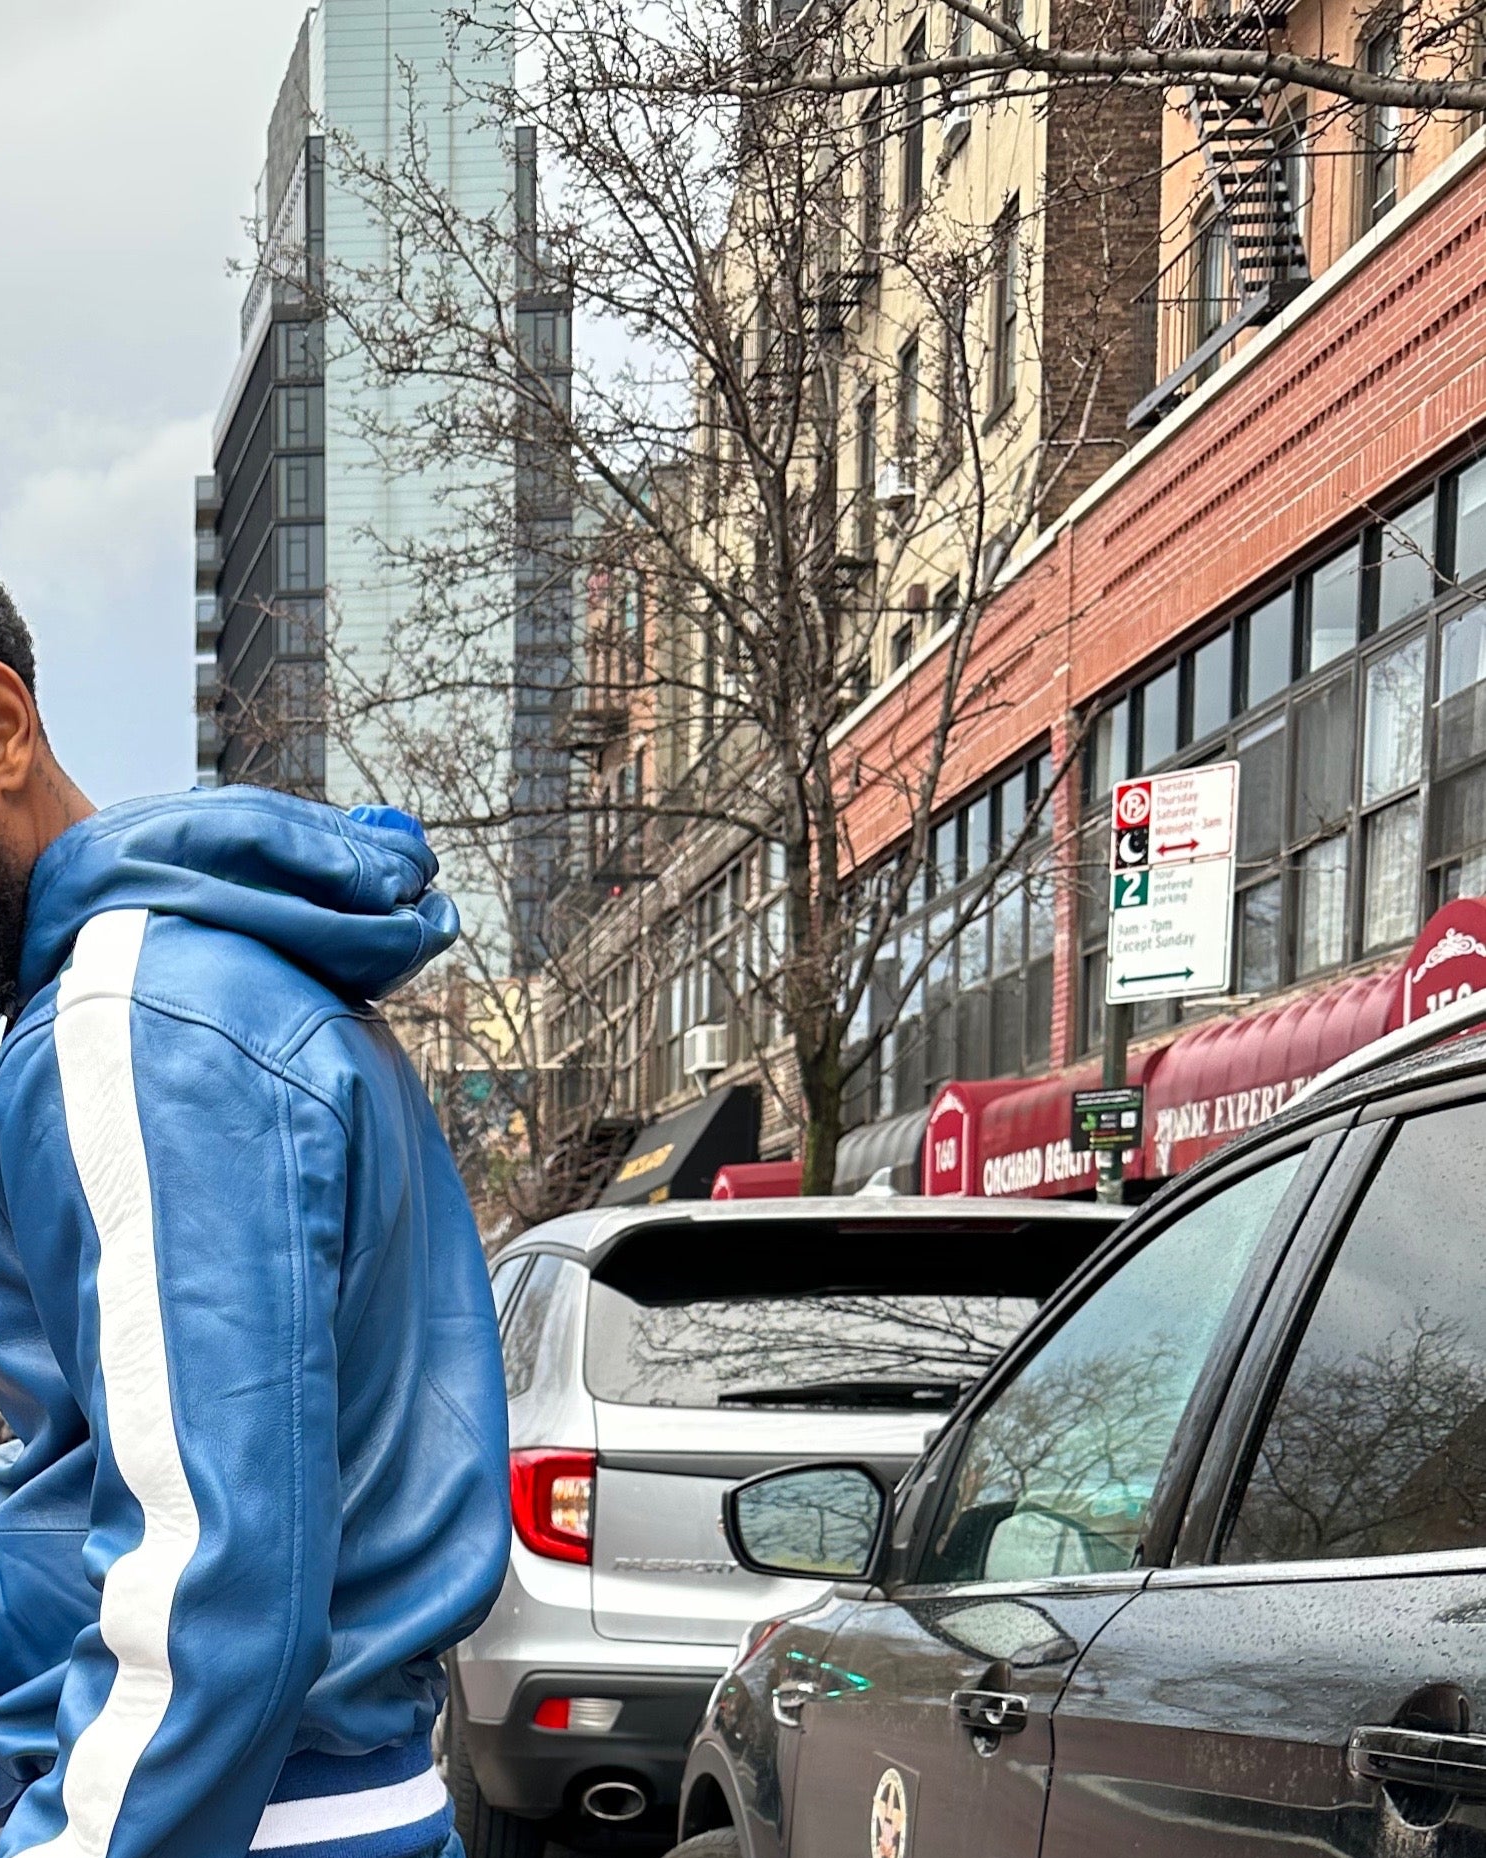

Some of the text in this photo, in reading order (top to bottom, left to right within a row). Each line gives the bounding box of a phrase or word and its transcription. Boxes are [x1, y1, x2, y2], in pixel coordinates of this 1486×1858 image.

[1157, 779, 1194, 793] Tuesday
[1156, 793, 1199, 807] Thursday
[1155, 806, 1197, 821] Saturday
[1155, 821, 1193, 836] Midnight
[1201, 816, 1222, 831] 3am
[1121, 871, 1142, 906] 2
[1153, 878, 1193, 893] metered
[1152, 891, 1188, 908] parking
[1116, 922, 1139, 936] 9am
[1150, 919, 1173, 934] 7pm
[1116, 933, 1196, 954] Except Sunday
[1213, 1082, 1288, 1134] EXPERT
[983, 1147, 1043, 1197] ORCHARD
[613, 1556, 739, 1574] PASSPORT
